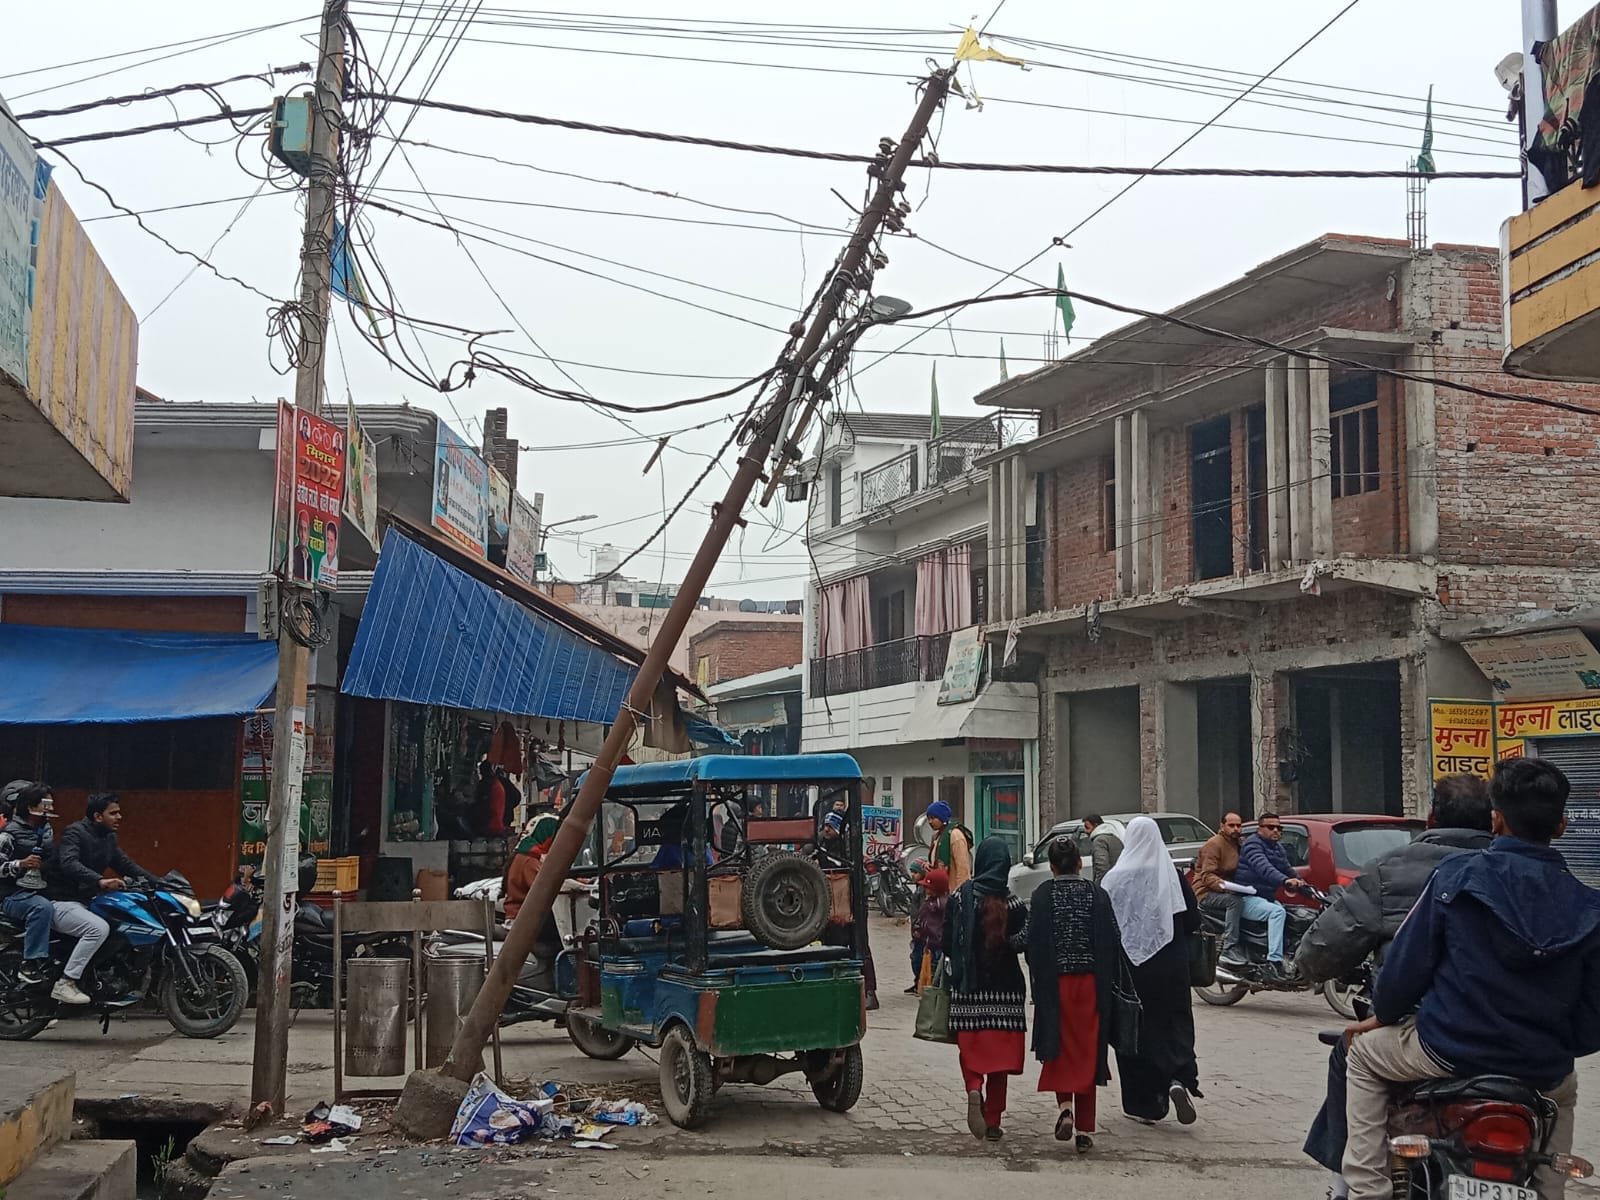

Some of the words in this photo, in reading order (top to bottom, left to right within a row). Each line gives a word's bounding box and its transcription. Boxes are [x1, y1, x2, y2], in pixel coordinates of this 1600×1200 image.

[299, 456, 342, 492] 2027
[1498, 705, 1555, 736] मुन्ना
[1435, 727, 1490, 752] मुन्ना
